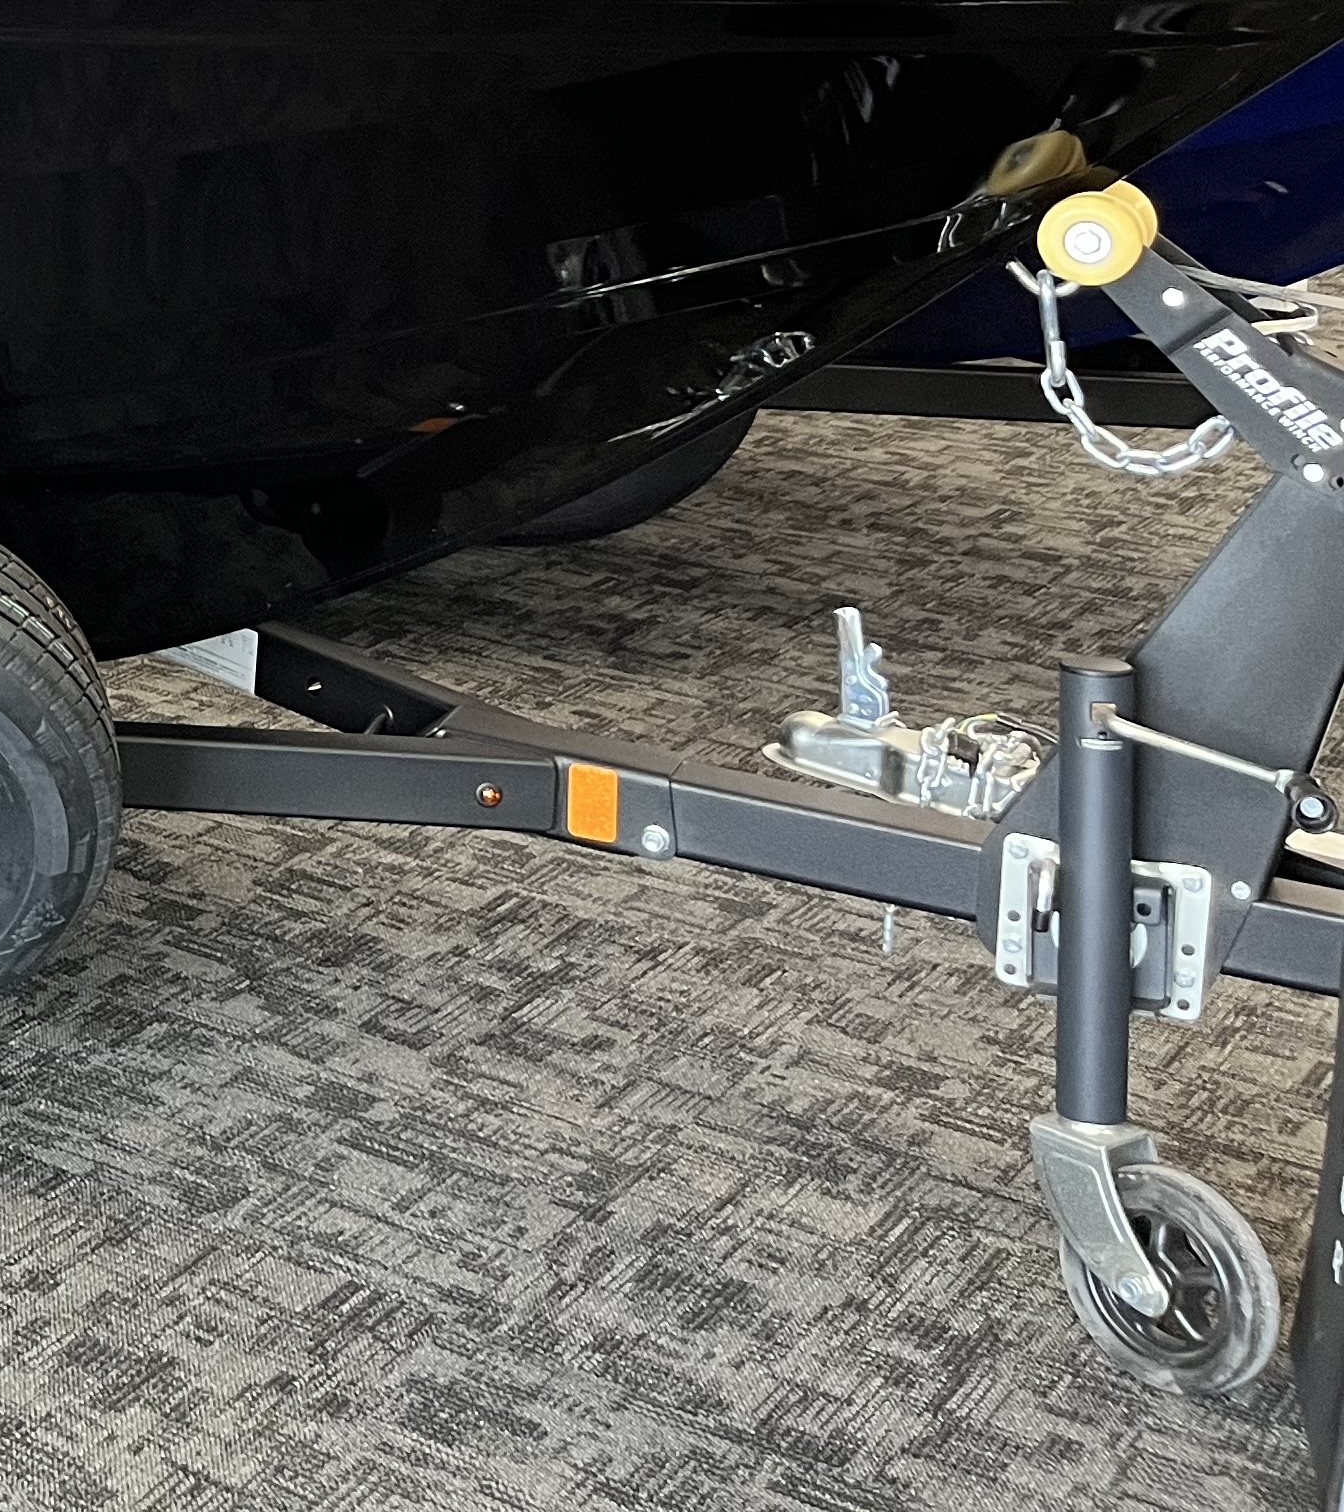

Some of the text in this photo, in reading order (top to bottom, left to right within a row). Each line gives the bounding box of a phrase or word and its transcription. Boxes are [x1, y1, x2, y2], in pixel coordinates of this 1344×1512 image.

[1193, 342, 1322, 453] PERFORMANCE WINCH
[1200, 328, 1343, 450] Profile
